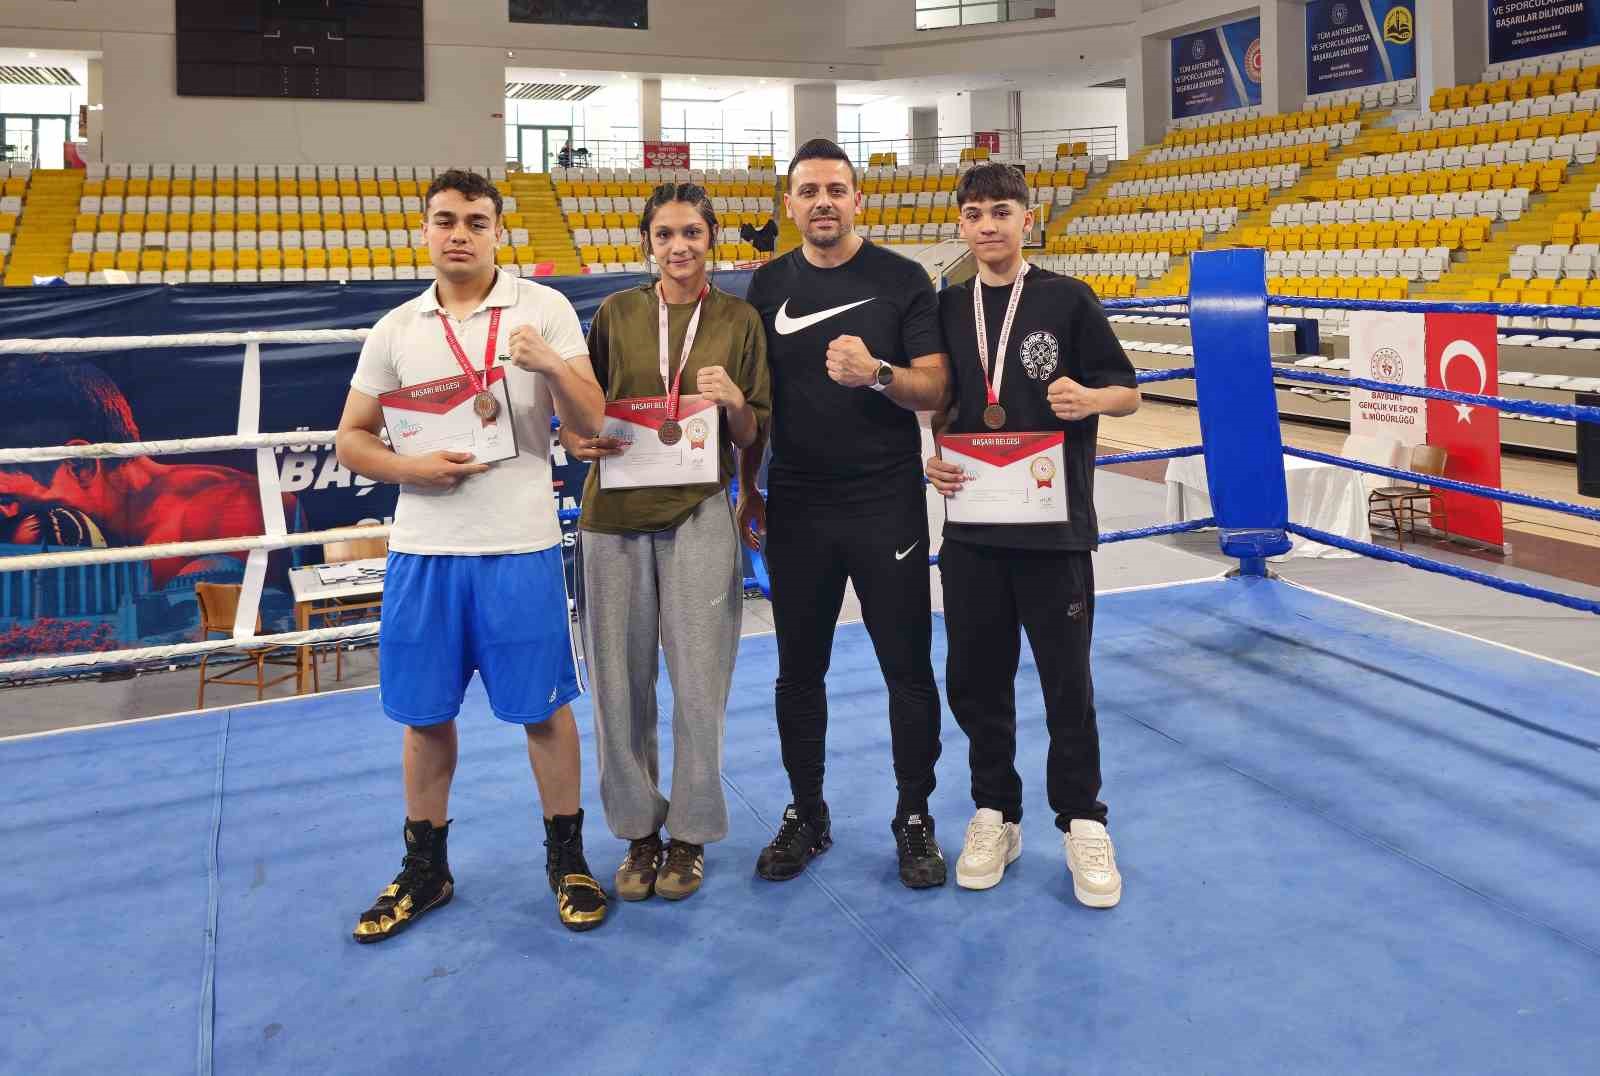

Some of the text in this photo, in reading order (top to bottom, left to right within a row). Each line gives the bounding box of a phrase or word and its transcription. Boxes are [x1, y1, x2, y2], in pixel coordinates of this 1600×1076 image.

[1492, 6, 1504, 16] VE
[1496, 2, 1584, 28] BAŞARILAR DİLİYORUM
[1359, 401, 1418, 413] GENÇLİK VE SPOR
[1369, 413, 1415, 424] MÜDÜRLÜĞÜ
[972, 435, 1020, 447] BAŞARI BELGESİ
